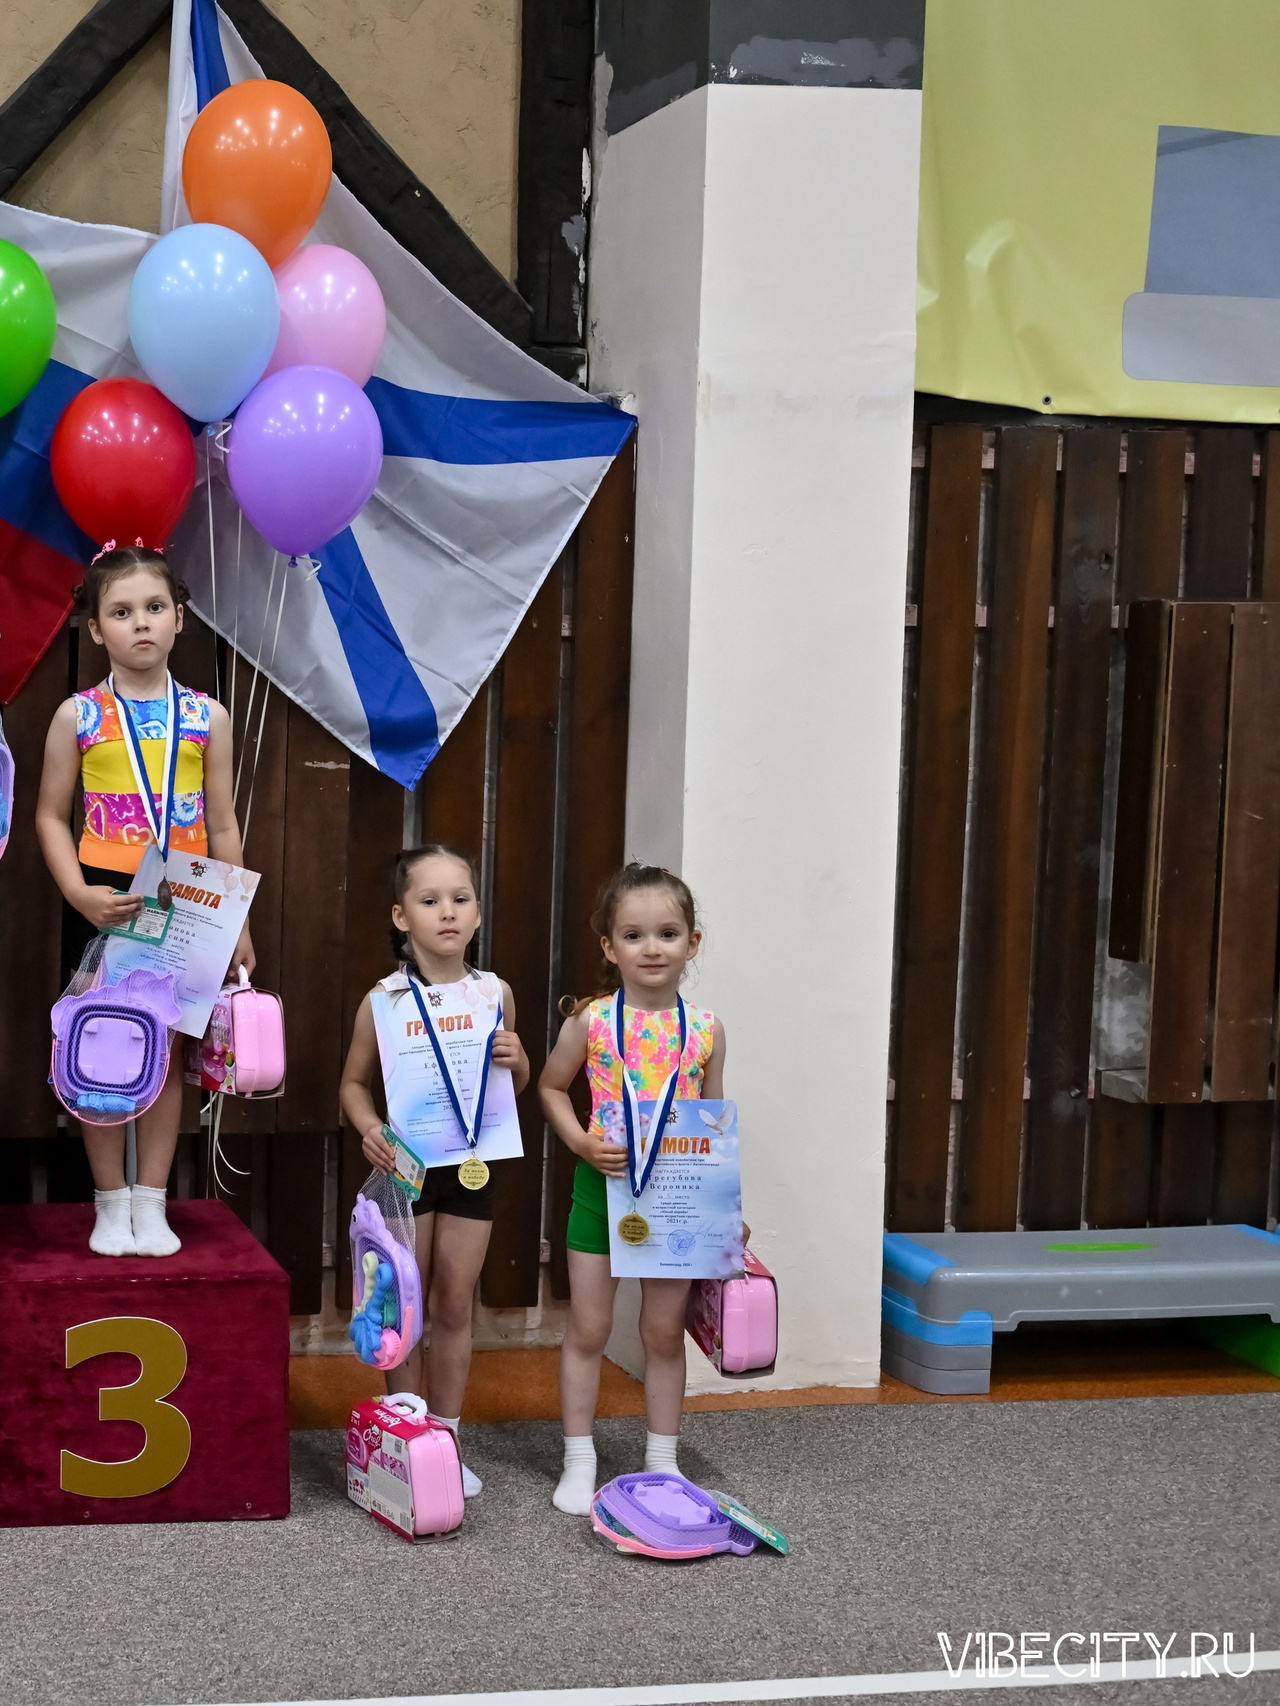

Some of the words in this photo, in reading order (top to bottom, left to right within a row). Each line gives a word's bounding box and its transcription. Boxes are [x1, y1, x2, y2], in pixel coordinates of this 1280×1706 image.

[168, 880, 222, 910] РАМОТА
[641, 1136, 711, 1155] МОТА
[649, 1183, 700, 1191] Вероника
[59, 1316, 192, 1499] 3
